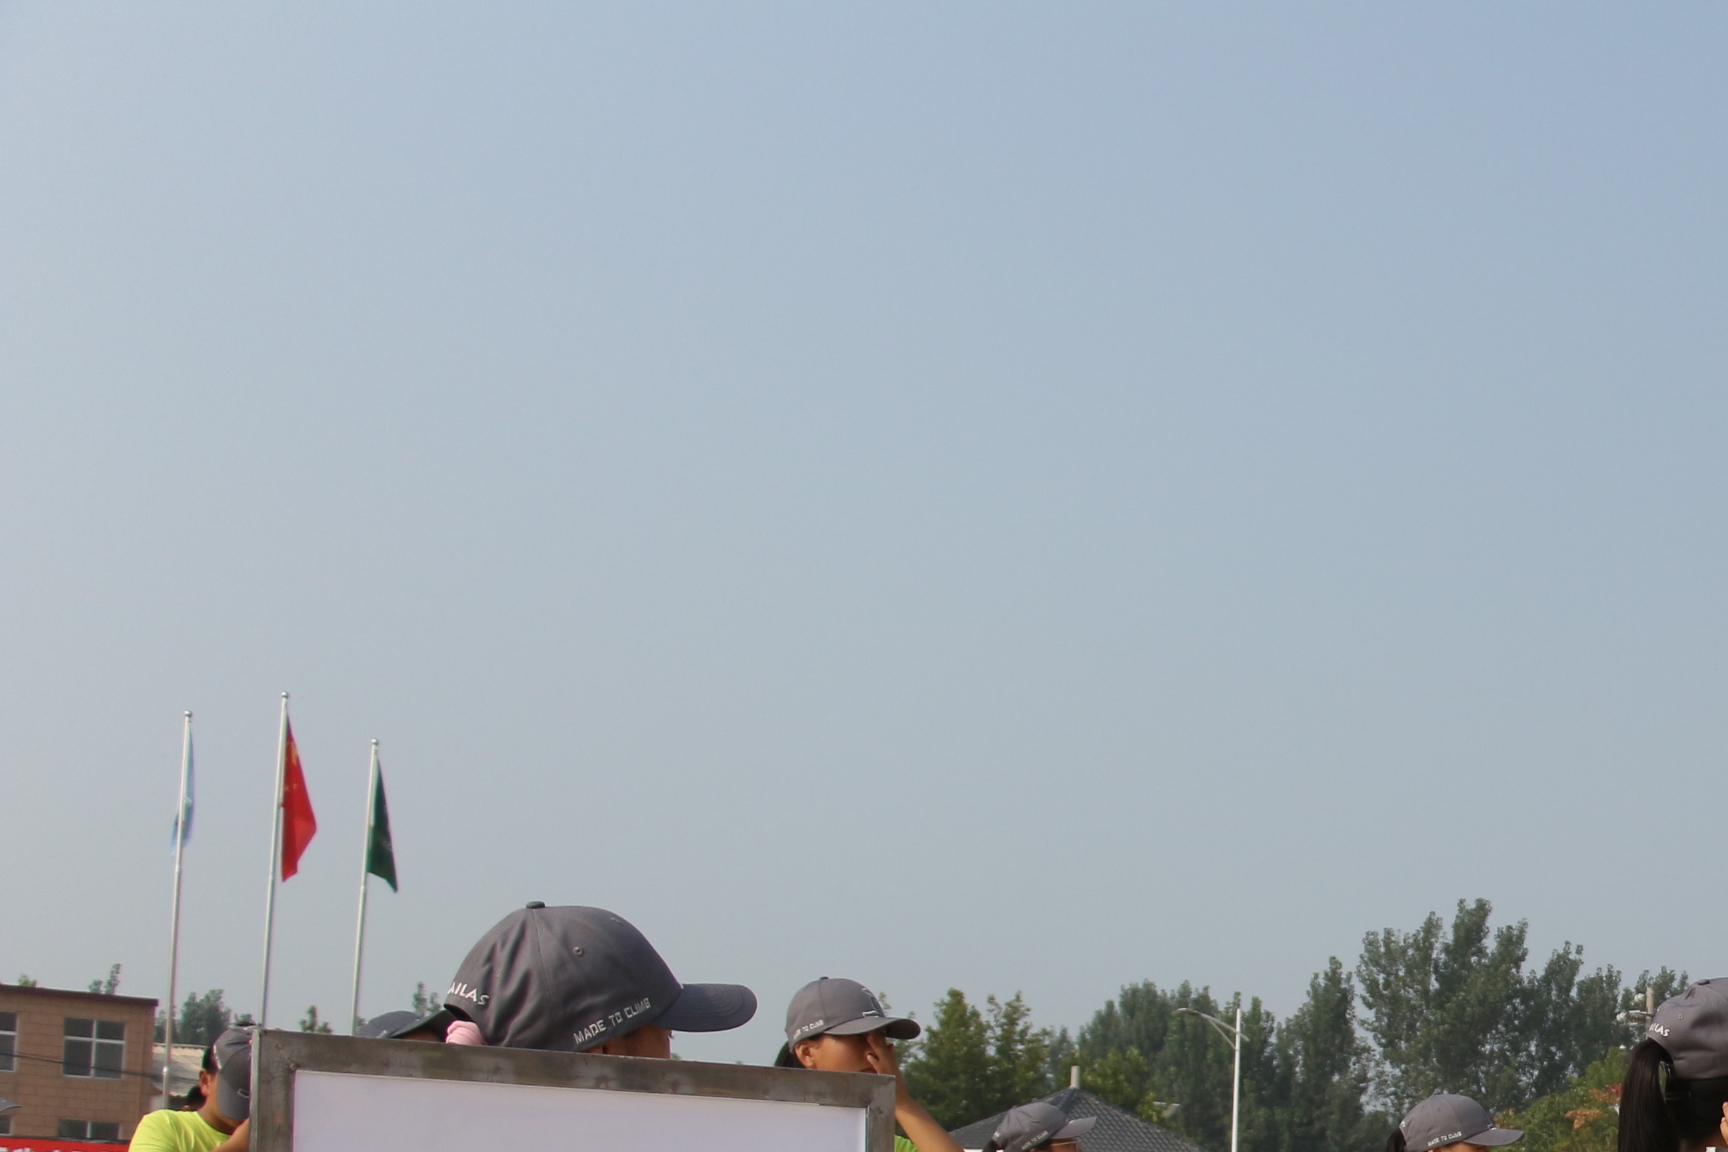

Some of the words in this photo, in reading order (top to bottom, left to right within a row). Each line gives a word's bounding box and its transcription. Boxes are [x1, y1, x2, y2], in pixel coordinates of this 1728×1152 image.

[448, 981, 490, 1005] AILAS
[573, 1019, 607, 1044] MADE
[608, 1011, 624, 1028] TO
[626, 997, 652, 1019] CLIMB
[1648, 1022, 1670, 1037] AILAS
